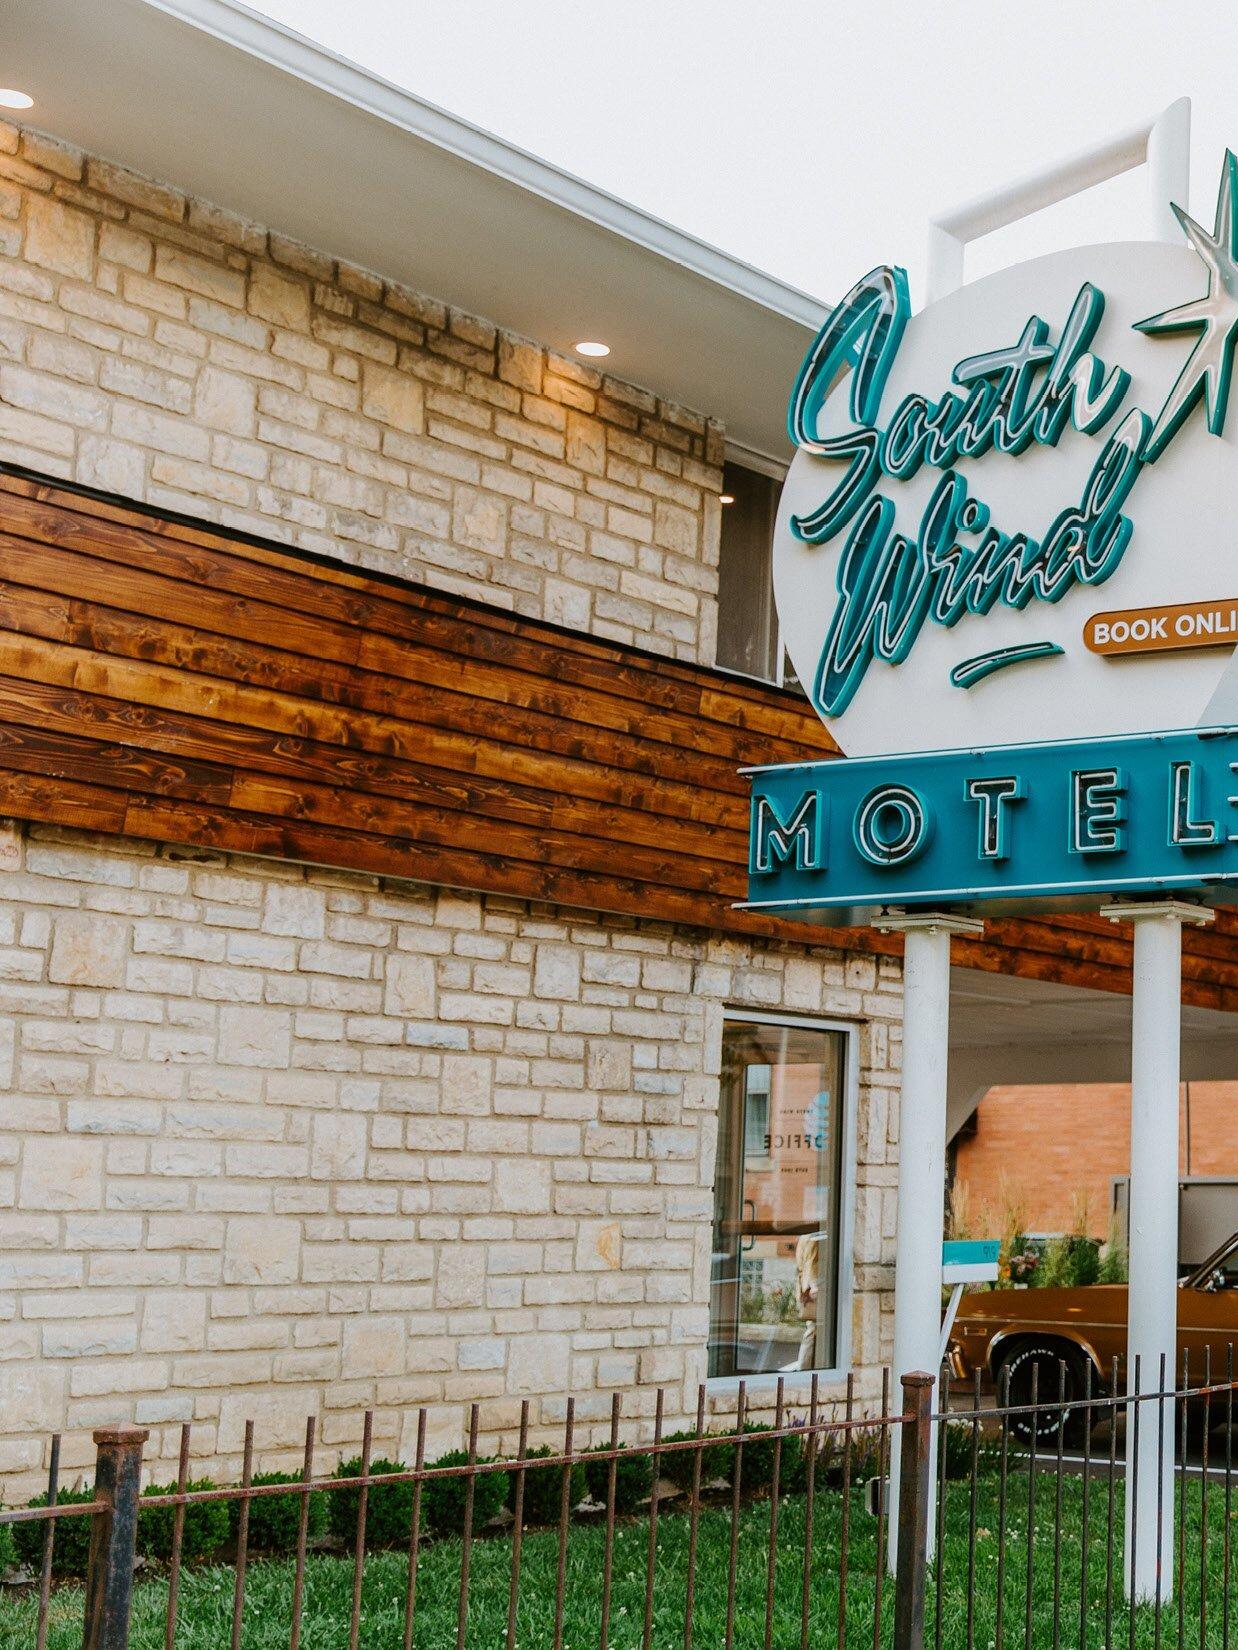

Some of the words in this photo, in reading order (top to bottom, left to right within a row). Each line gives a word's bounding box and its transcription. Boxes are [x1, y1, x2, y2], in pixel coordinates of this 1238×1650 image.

[788, 265, 1129, 545] South
[813, 407, 1152, 718] Wind
[1093, 616, 1168, 645] BOOK
[749, 761, 1227, 875] MOTEL
